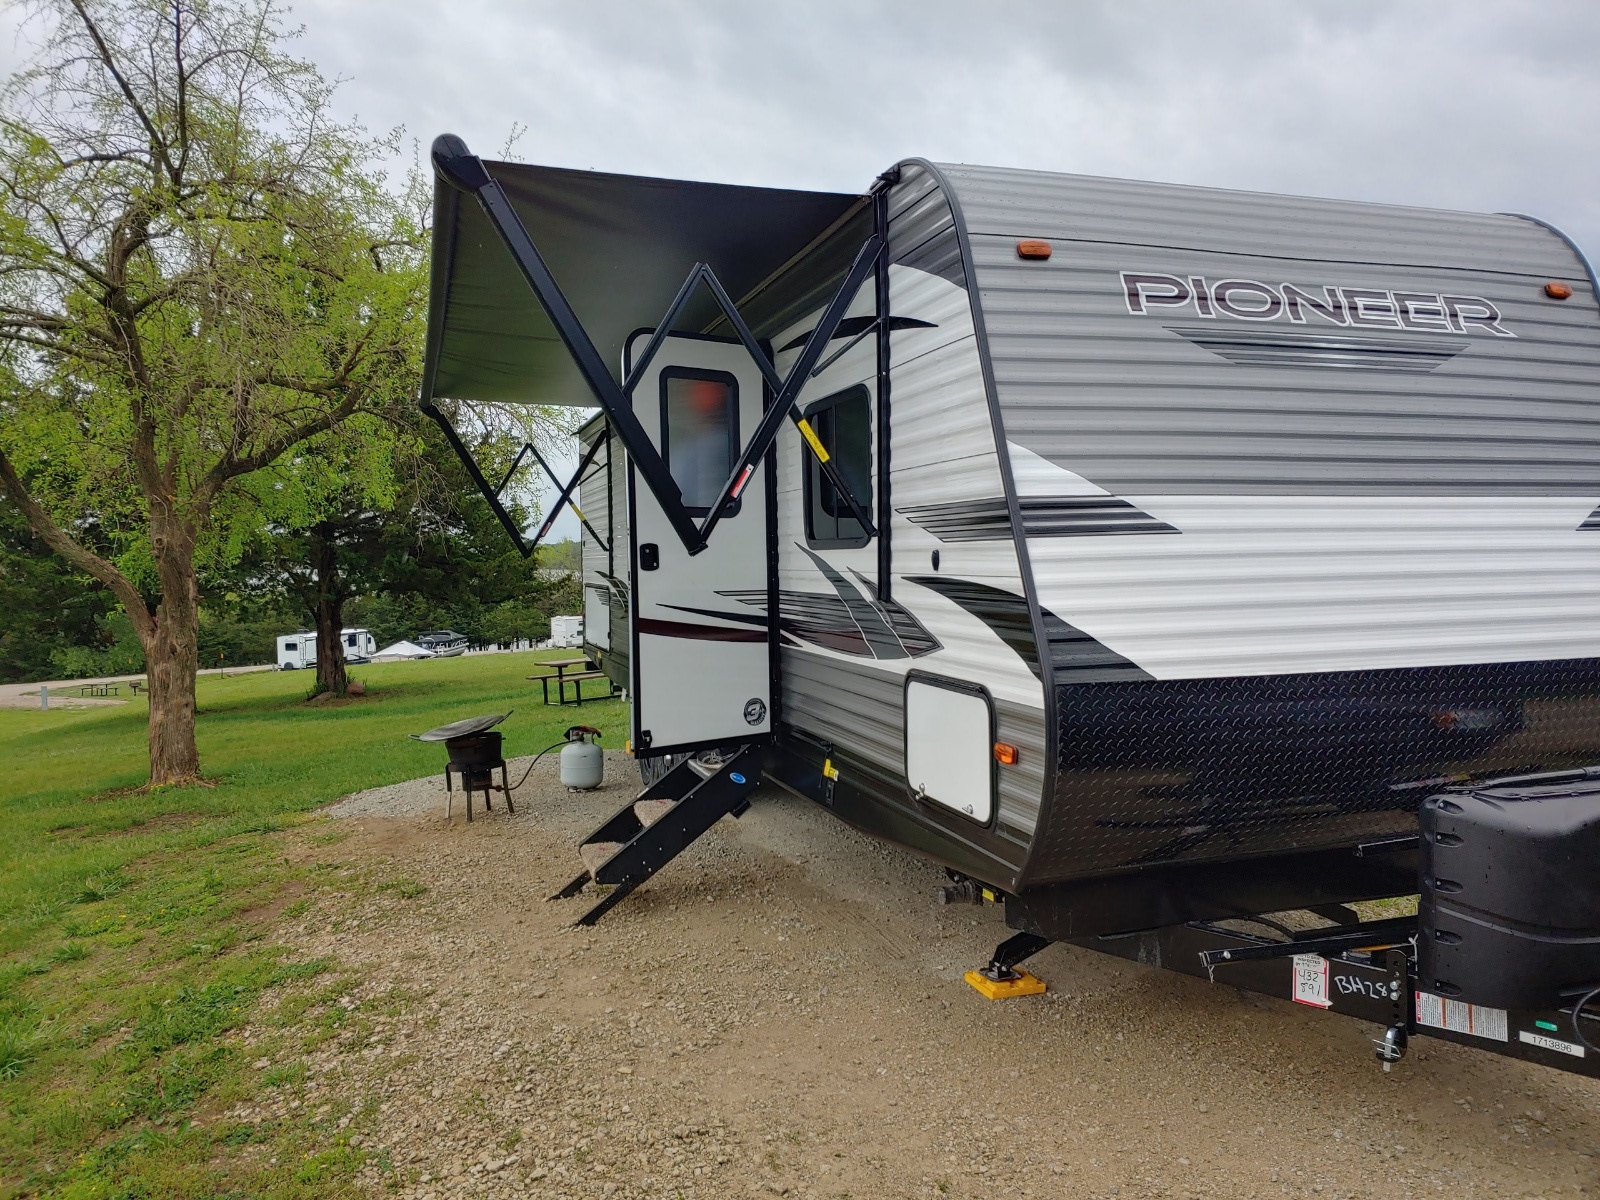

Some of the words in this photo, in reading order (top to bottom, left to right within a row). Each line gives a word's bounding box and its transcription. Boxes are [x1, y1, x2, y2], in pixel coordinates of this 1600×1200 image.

[1119, 271, 1518, 337] PIONEER
[1298, 969, 1319, 983] 432
[1334, 975, 1388, 999] BH28
[1532, 1035, 1572, 1054] 1713896
